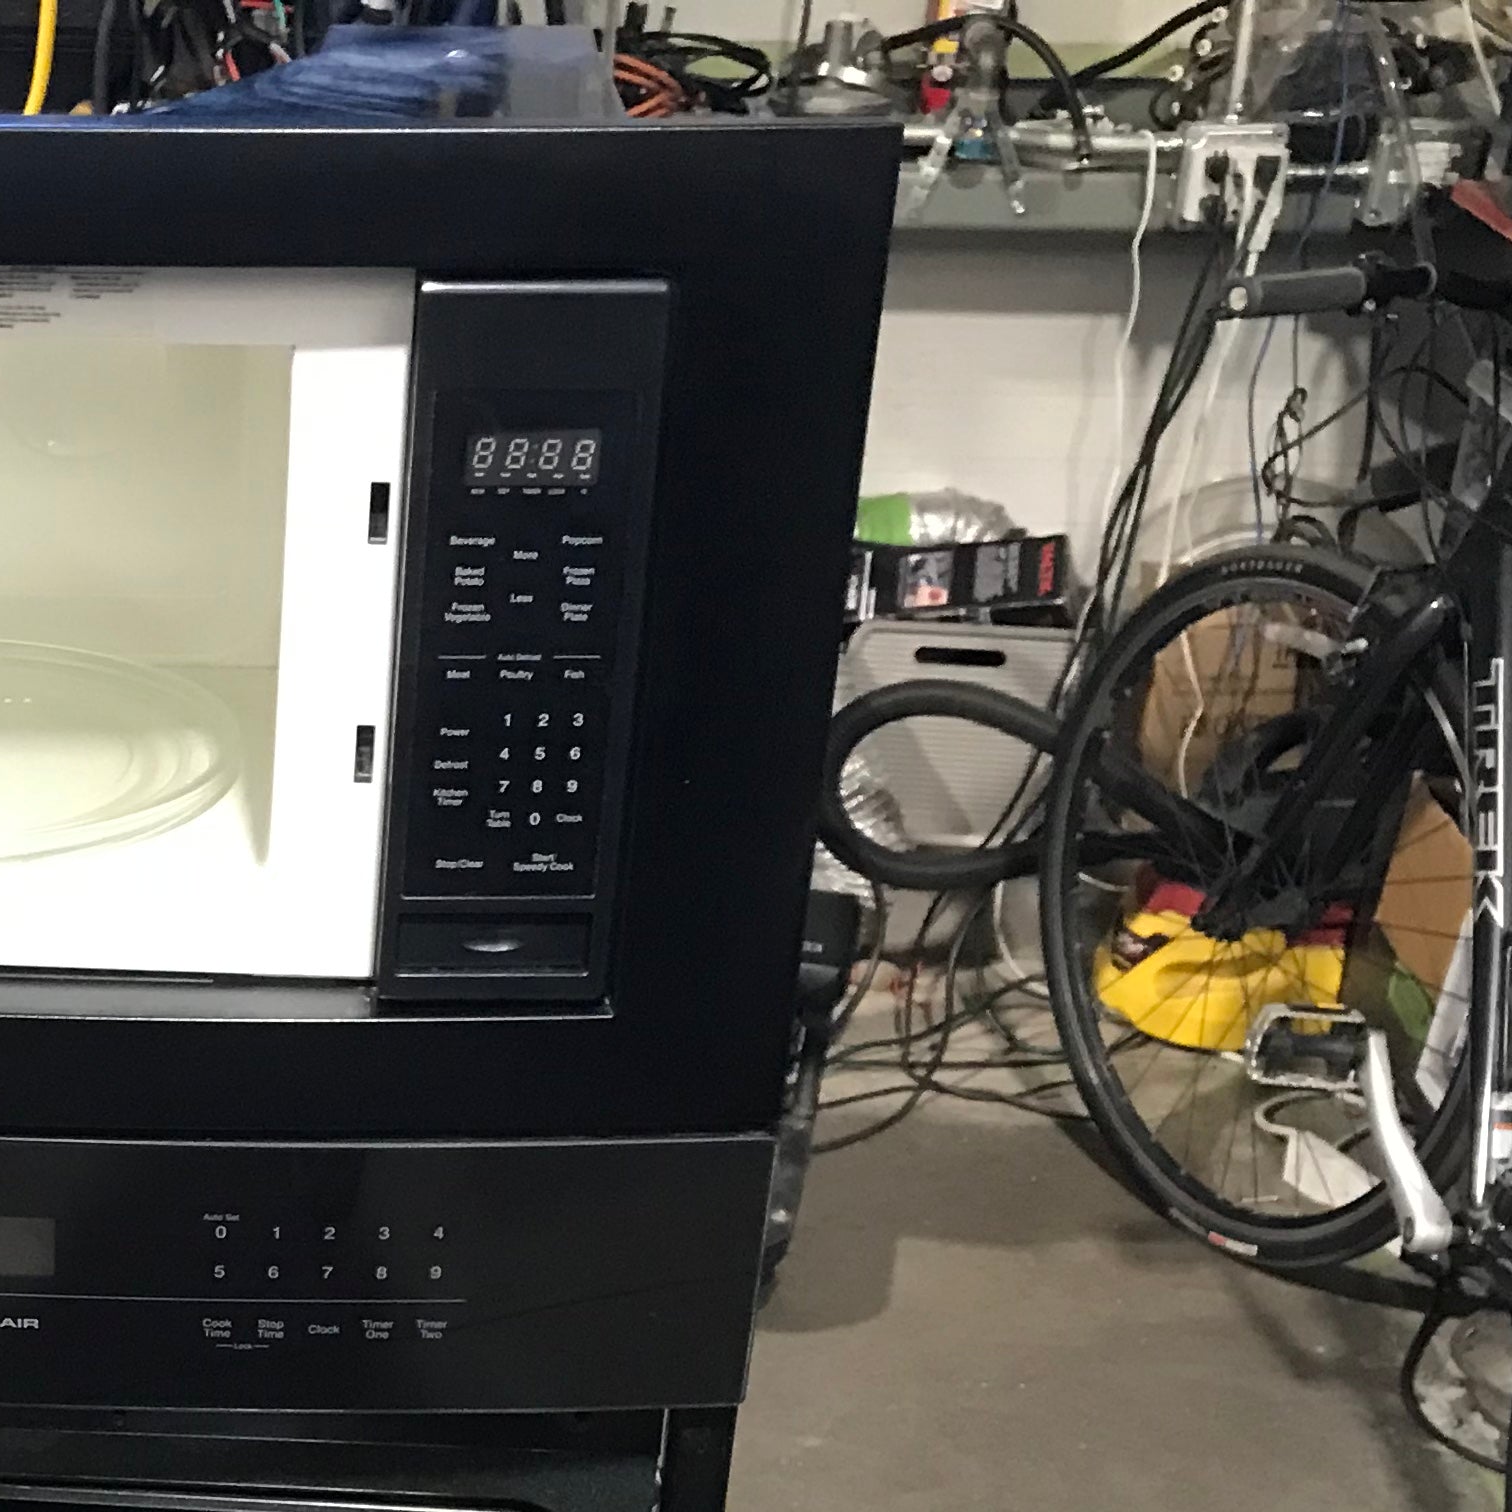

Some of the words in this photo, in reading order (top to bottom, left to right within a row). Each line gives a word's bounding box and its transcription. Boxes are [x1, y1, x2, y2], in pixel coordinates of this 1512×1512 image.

[500, 670, 533, 680] Poultry
[504, 714, 511, 726] 1
[538, 713, 549, 727] 2
[573, 713, 583, 726] 3
[440, 728, 469, 736] Power
[500, 748, 509, 759] 4
[535, 747, 545, 760] 5
[570, 747, 580, 760] 6
[499, 781, 510, 792] 7
[532, 780, 542, 793] 8
[567, 780, 577, 792] 9
[1473, 656, 1505, 929] TREK
[530, 813, 540, 825] 0
[549, 861, 573, 870] Cook
[216, 1226, 226, 1238] 0
[273, 1227, 279, 1239] 1
[324, 1227, 335, 1239] 2
[379, 1227, 389, 1239] 3
[434, 1227, 443, 1239] 4
[214, 1265, 225, 1278] 5
[268, 1266, 278, 1278] 6
[322, 1266, 333, 1278] 7
[376, 1266, 387, 1279] 8
[430, 1266, 441, 1279] 9
[203, 1318, 232, 1329] Cook
[258, 1319, 284, 1330] Stop
[362, 1320, 393, 1329] Timer
[417, 1319, 447, 1330] Timer
[204, 1327, 230, 1338] Time
[258, 1328, 284, 1338] Time
[308, 1325, 339, 1334] Clock
[366, 1330, 389, 1339] One
[421, 1329, 442, 1338] Two
